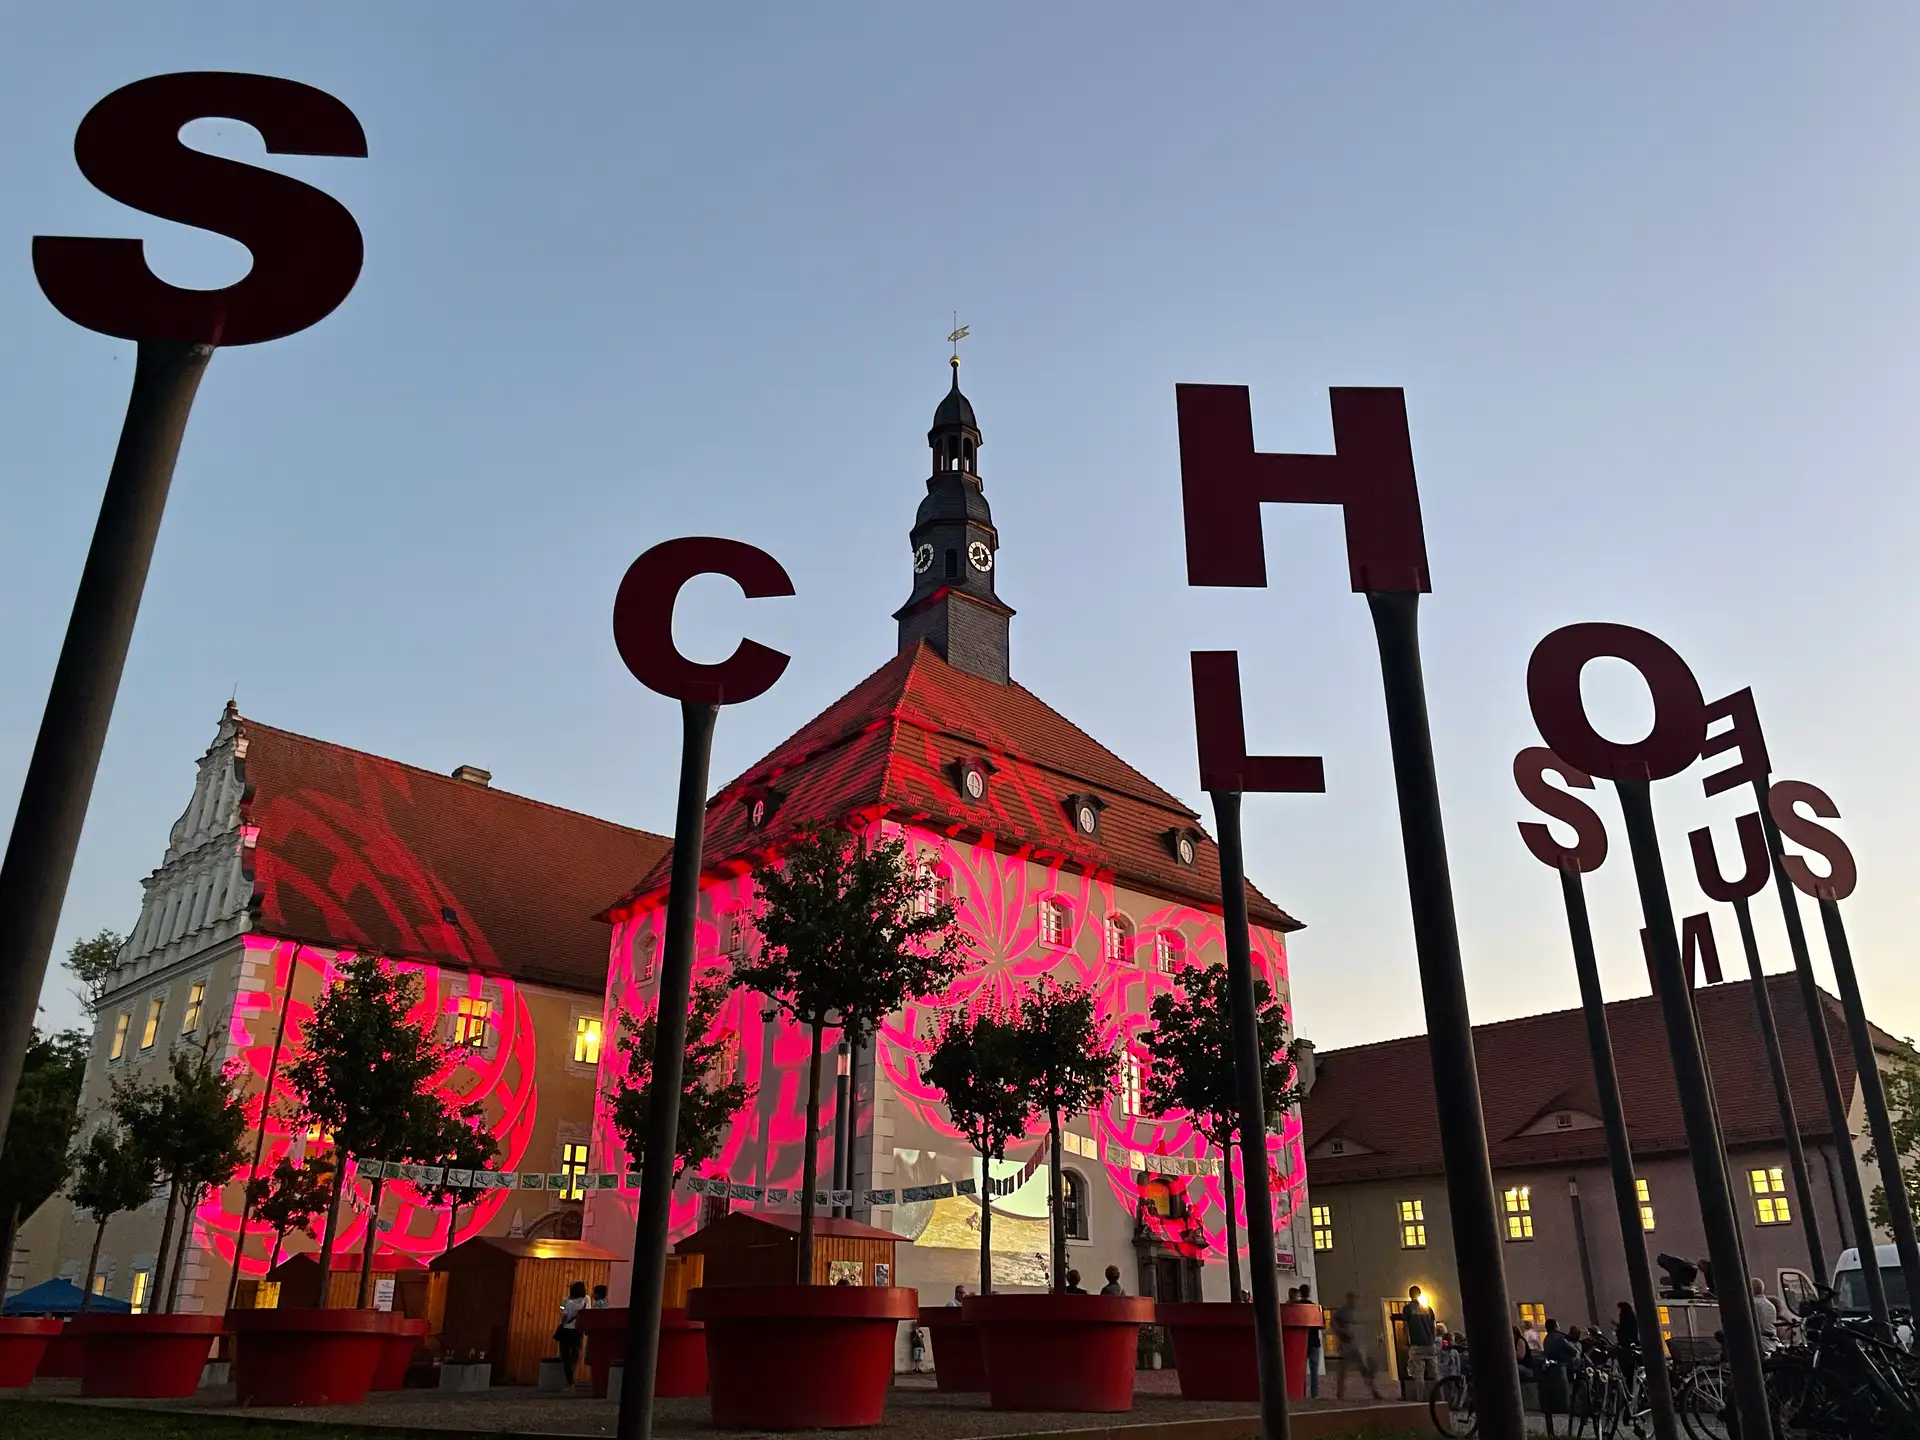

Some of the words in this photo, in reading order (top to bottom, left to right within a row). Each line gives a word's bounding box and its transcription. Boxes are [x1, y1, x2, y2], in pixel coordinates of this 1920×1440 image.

[32, 71, 368, 345] S
[1176, 383, 1432, 594] H
[613, 537, 796, 704] C
[1526, 622, 1705, 782] O
[1190, 651, 1326, 793] L
